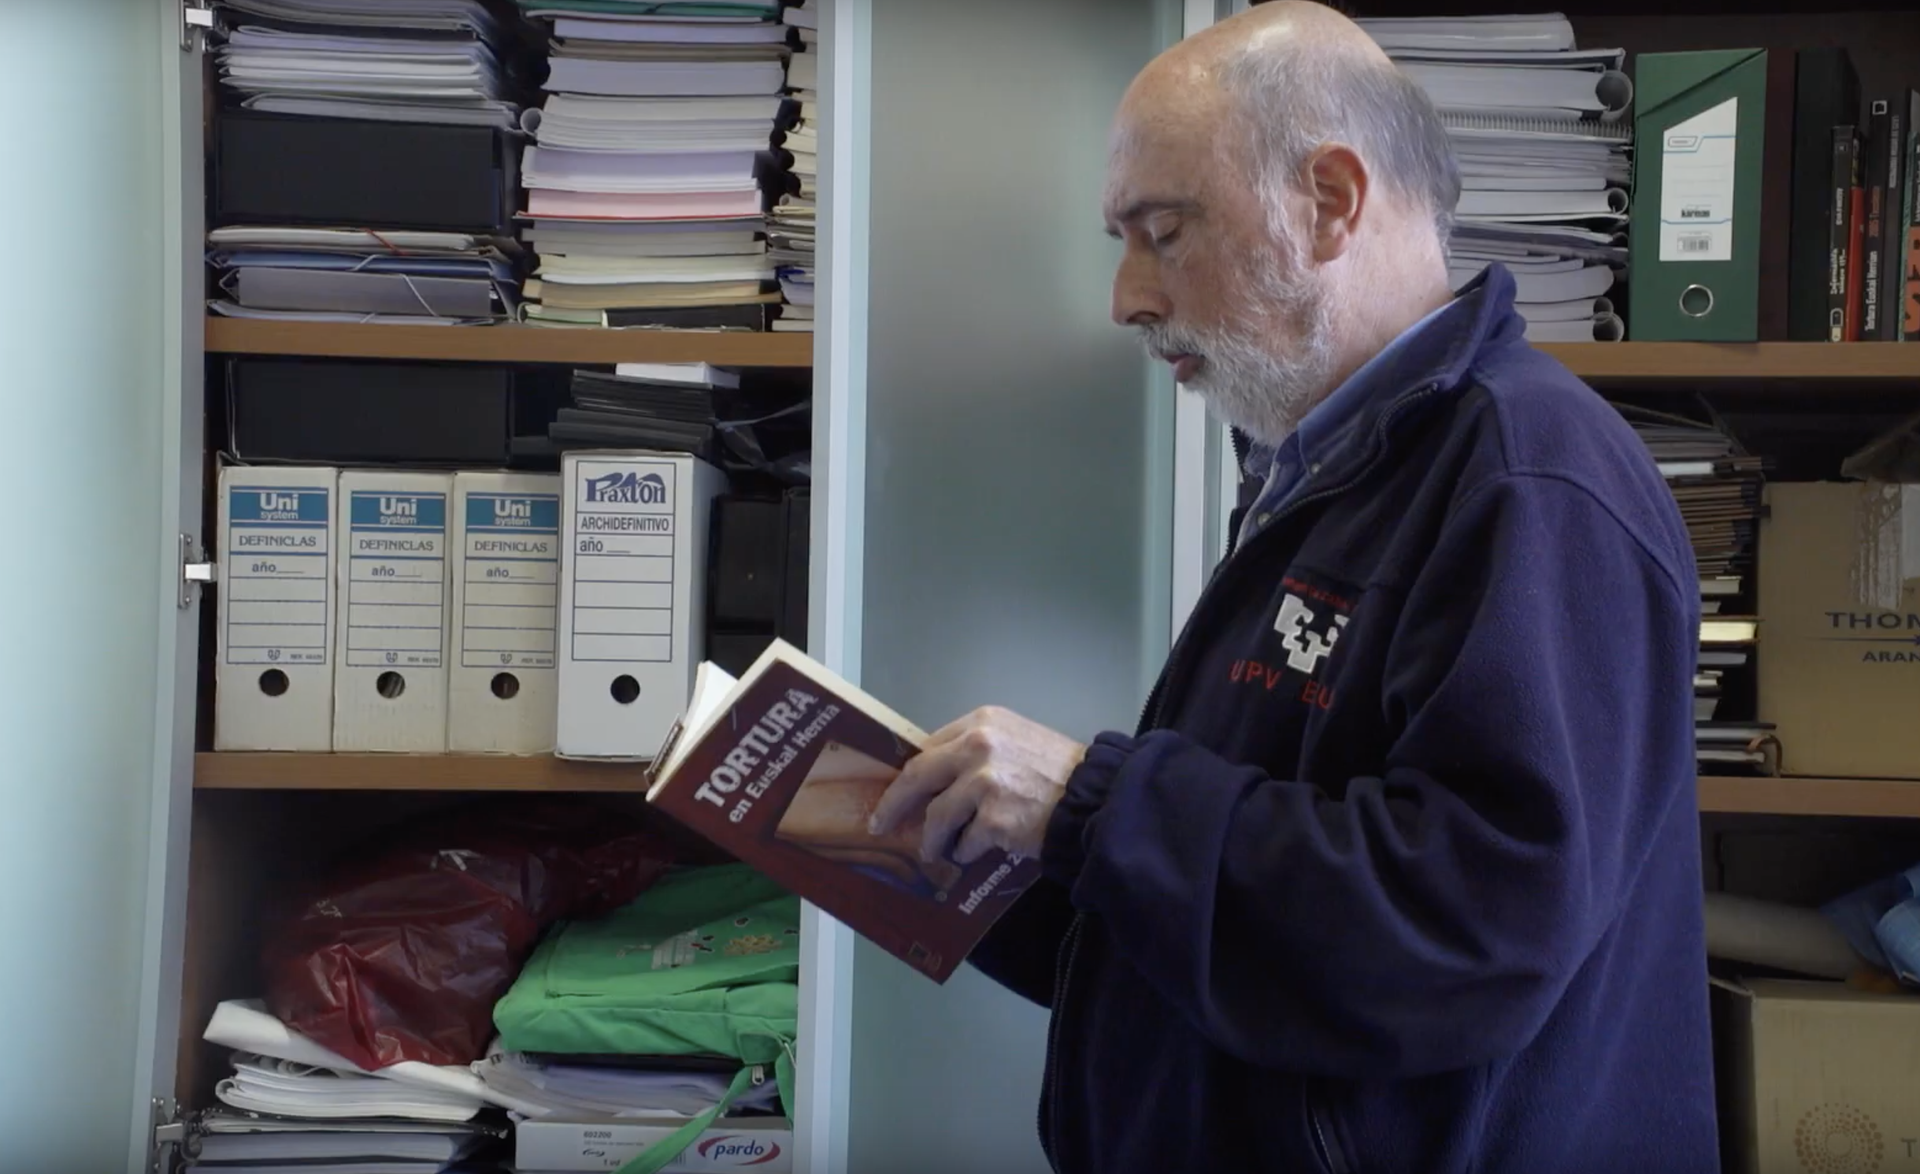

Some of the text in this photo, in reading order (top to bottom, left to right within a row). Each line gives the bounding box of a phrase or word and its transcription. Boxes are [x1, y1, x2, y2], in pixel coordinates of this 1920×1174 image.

[584, 472, 667, 504] Praxton
[260, 492, 299, 512] Uni
[380, 497, 417, 516] Uni
[494, 499, 532, 517] Uni
[260, 510, 299, 522] system
[379, 515, 417, 526] system
[494, 516, 532, 527] system
[580, 516, 670, 532] ARCHIDEFINITIVO
[238, 534, 317, 547] DEFINICLAS
[358, 539, 434, 552] DEFINICLAS
[474, 540, 549, 553] DEFINICLAS
[1228, 659, 1336, 709] UPV EU
[693, 687, 820, 811] TORTURA
[728, 703, 842, 825] en Euskal Herria
[957, 862, 1013, 916] Informe
[714, 1139, 765, 1161] pardo
